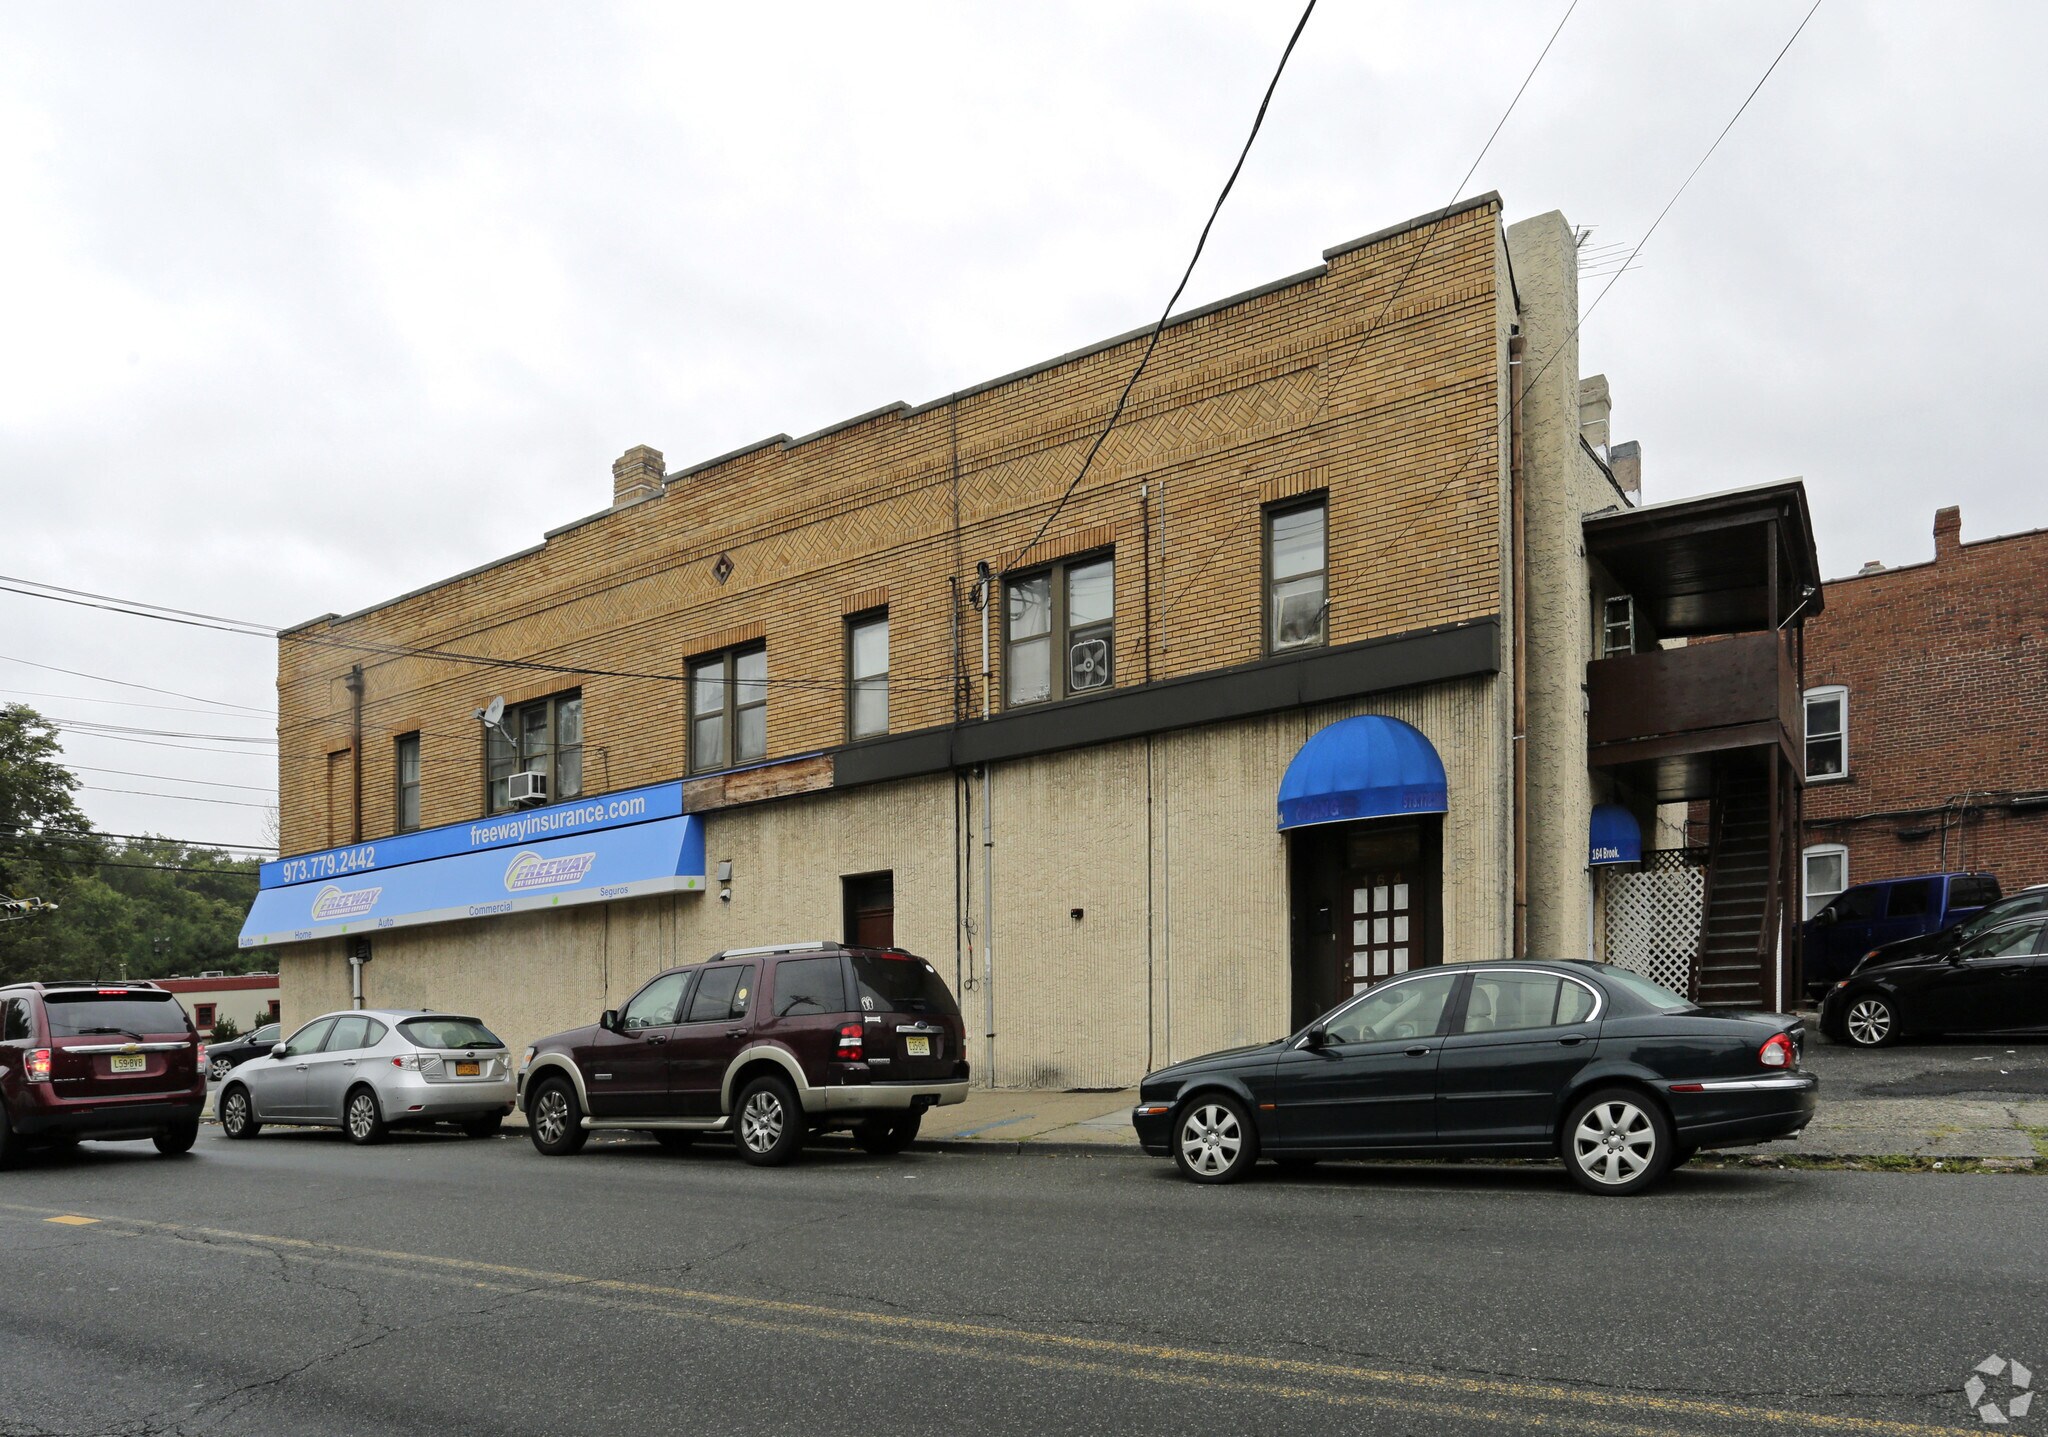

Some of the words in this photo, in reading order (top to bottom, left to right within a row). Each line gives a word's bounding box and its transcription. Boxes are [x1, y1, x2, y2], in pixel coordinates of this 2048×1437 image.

[470, 797, 645, 846] freewayinsurance.com
[283, 846, 375, 882] 973.779.2442
[516, 856, 593, 880] FREEWAY
[1592, 848, 1603, 860] 164
[320, 889, 379, 909] FREEWAY
[240, 938, 254, 947] Auto
[294, 931, 312, 939] Home
[378, 918, 394, 928] Auto
[469, 901, 513, 916] Commercial
[600, 887, 629, 897] Seguros
